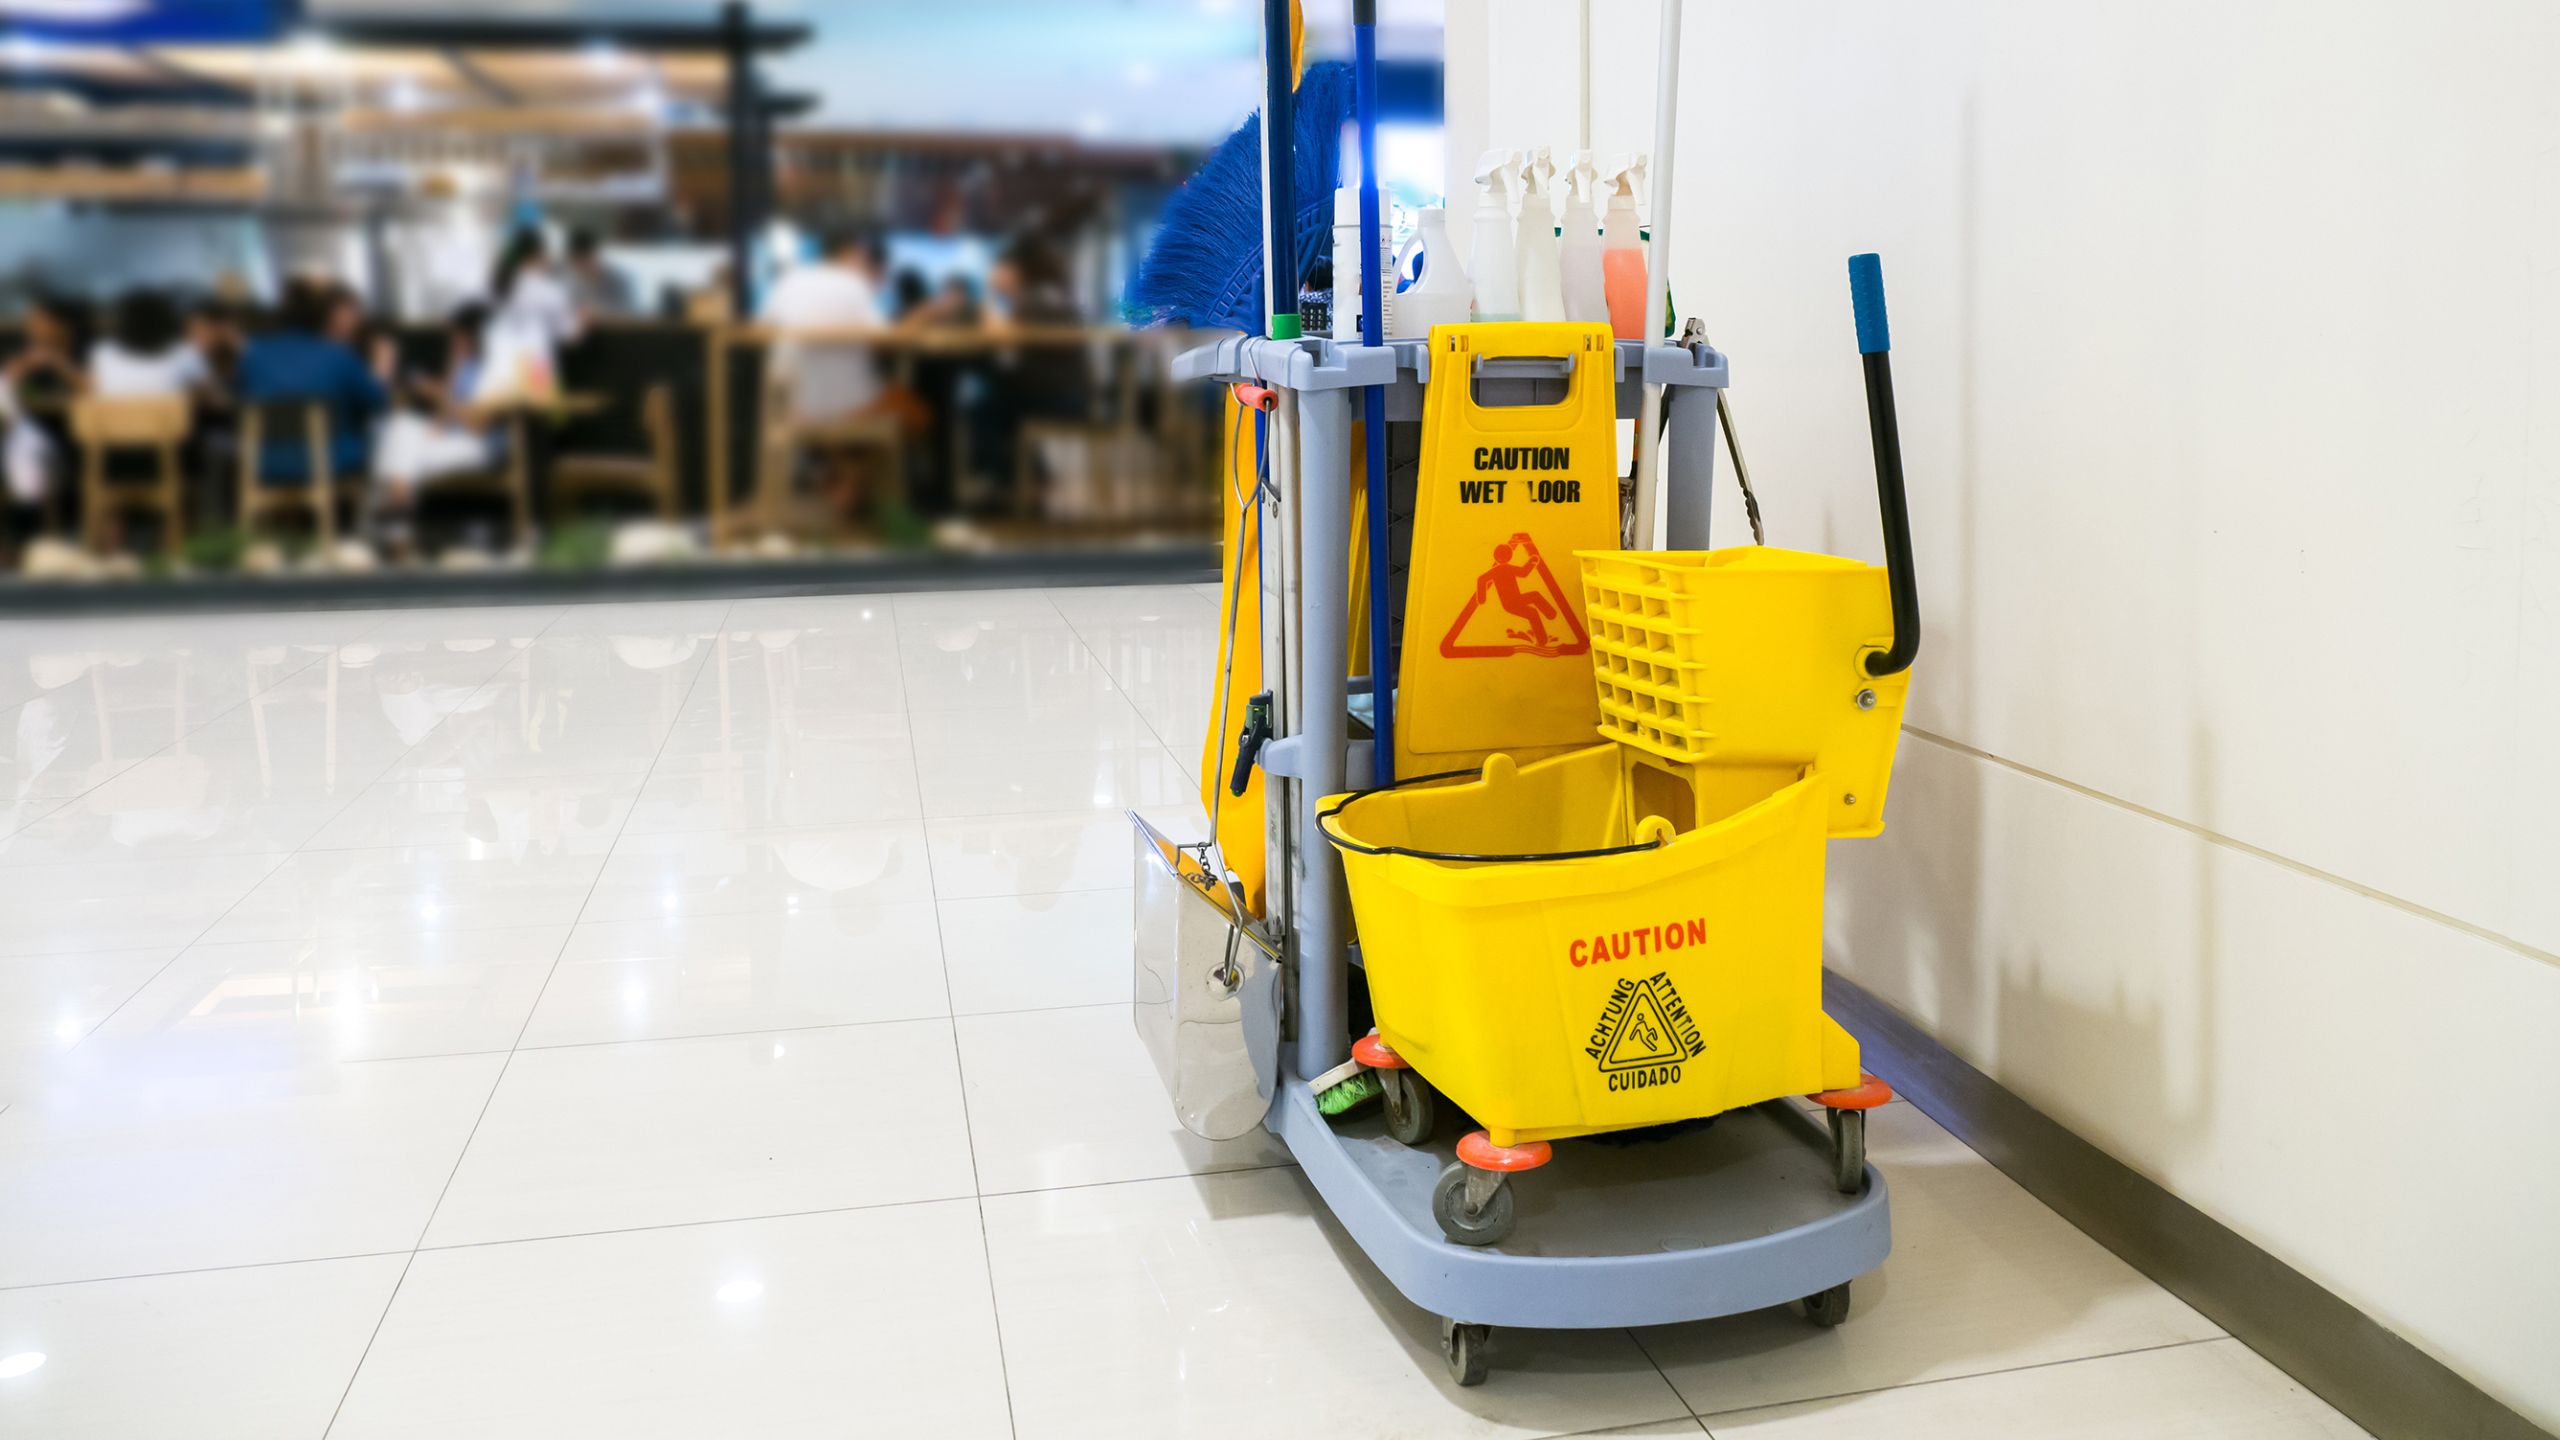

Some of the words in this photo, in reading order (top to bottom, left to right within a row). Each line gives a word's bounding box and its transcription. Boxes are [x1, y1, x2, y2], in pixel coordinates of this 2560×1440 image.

[1474, 446, 1570, 470] CAUTION
[1460, 481, 1508, 503] WET
[1516, 480, 1581, 503] LOOR
[1569, 917, 1707, 968] CAUTION
[1585, 977, 1635, 1060] ACHTUNG
[1650, 971, 1707, 1058] ATTENTION
[1608, 1064, 1681, 1092] CUIDADO
